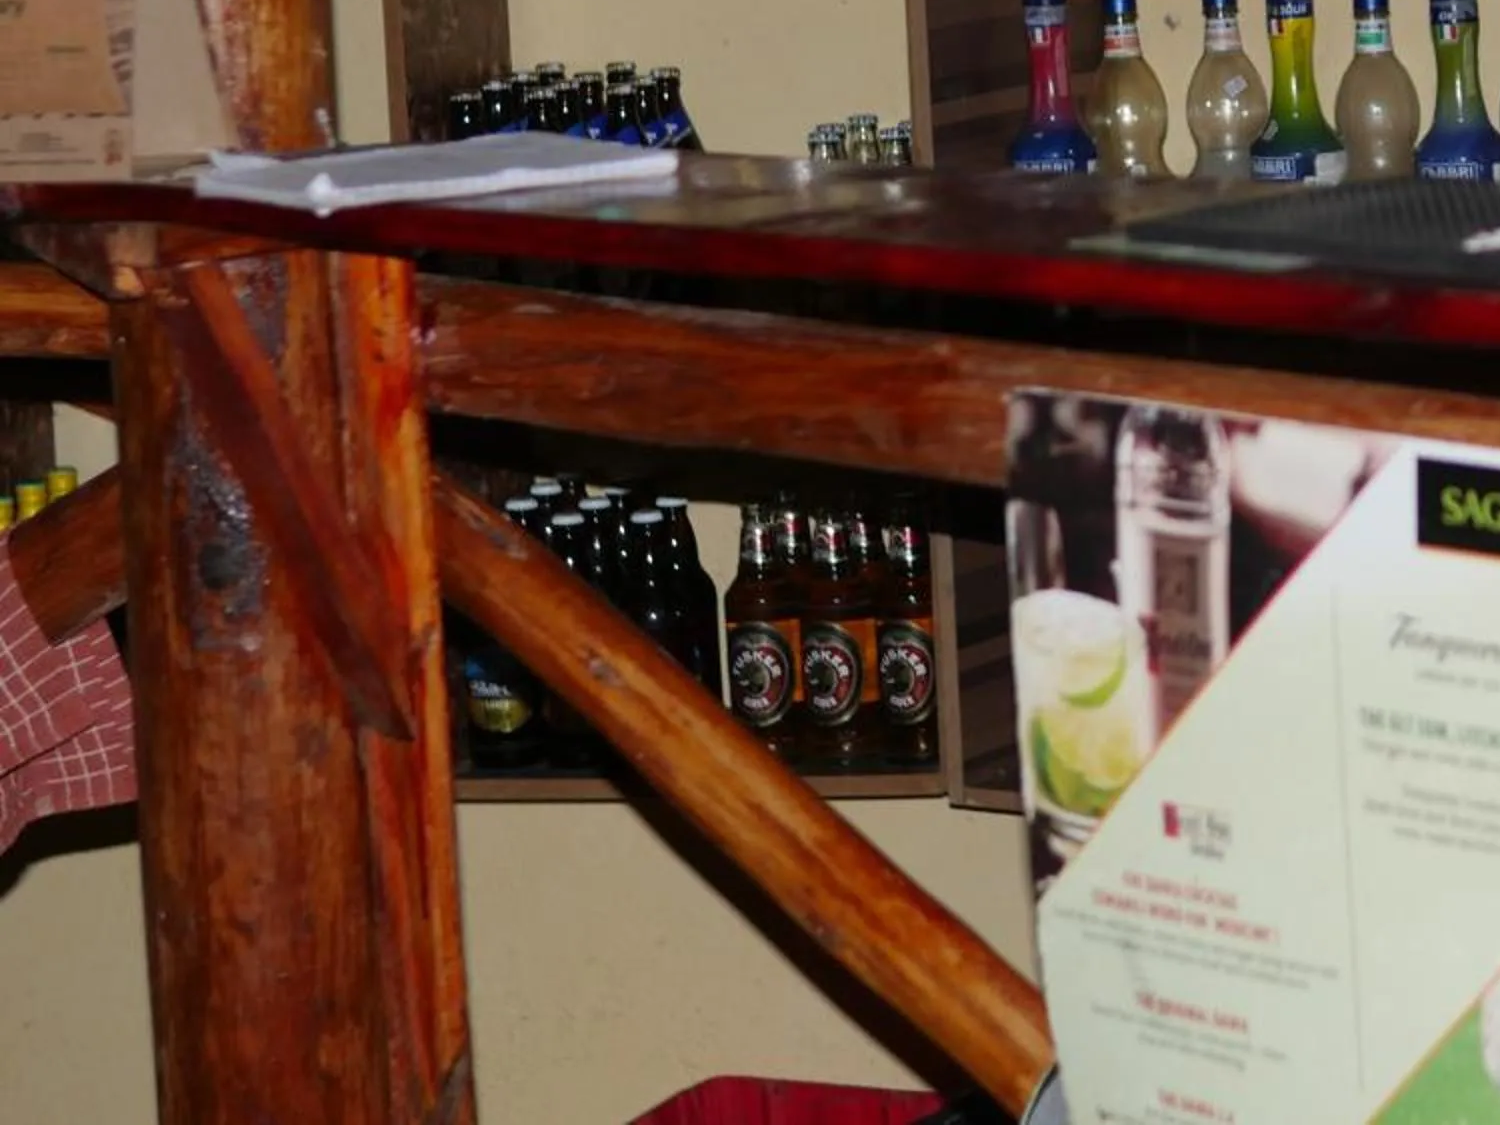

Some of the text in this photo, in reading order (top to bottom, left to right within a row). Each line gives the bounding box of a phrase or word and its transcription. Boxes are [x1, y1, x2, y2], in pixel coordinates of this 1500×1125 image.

[733, 649, 783, 679] TUSKER
[804, 648, 851, 678] TUSKER
[880, 648, 928, 678] TUSKER
